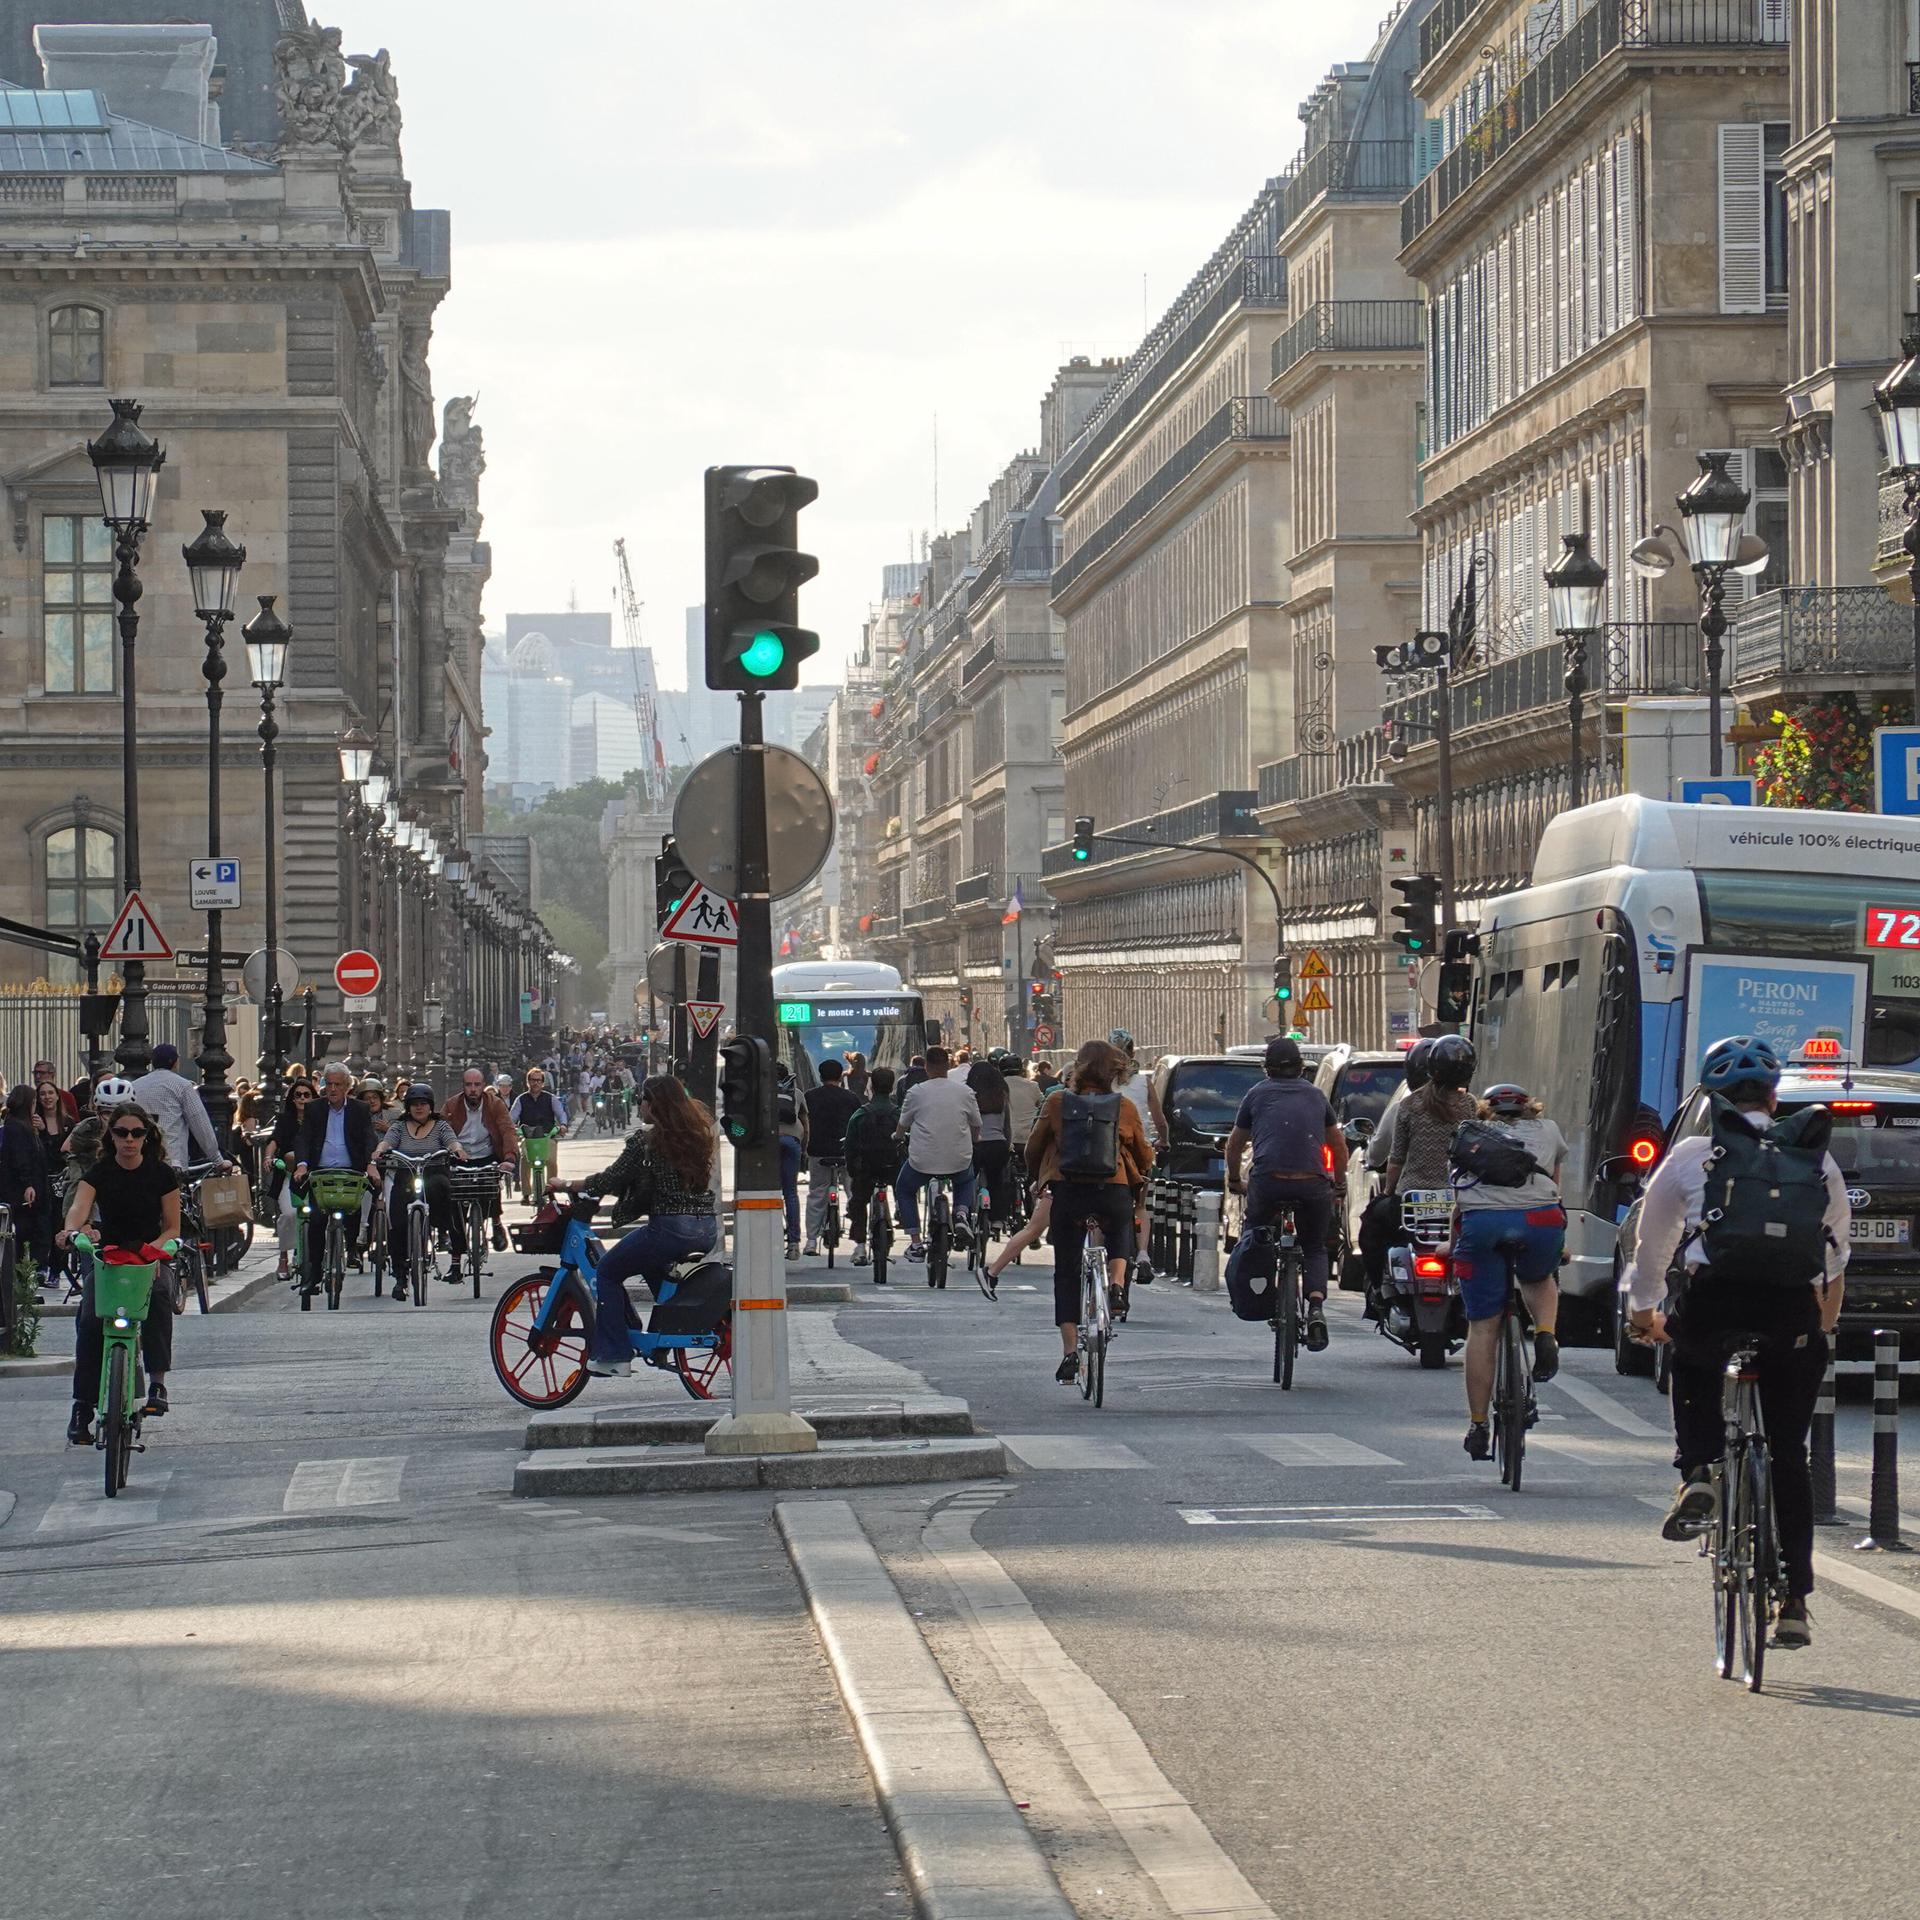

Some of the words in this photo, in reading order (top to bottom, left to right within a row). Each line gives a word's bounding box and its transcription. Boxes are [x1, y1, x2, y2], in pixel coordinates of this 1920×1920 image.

[1729, 831, 1794, 846] véhicule
[1799, 834, 1841, 848] 100%
[1845, 835, 1920, 853] électrique
[221, 865, 231, 880] P
[1877, 912, 1920, 944] 72
[1892, 975, 1920, 989] 1103
[1737, 978, 1818, 1001] PERONI
[787, 1006, 805, 1019] 21
[828, 1008, 854, 1017] monte
[873, 1006, 900, 1016] valide
[1749, 1006, 1804, 1016] AZZURRO
[1808, 1041, 1838, 1053] TAXI
